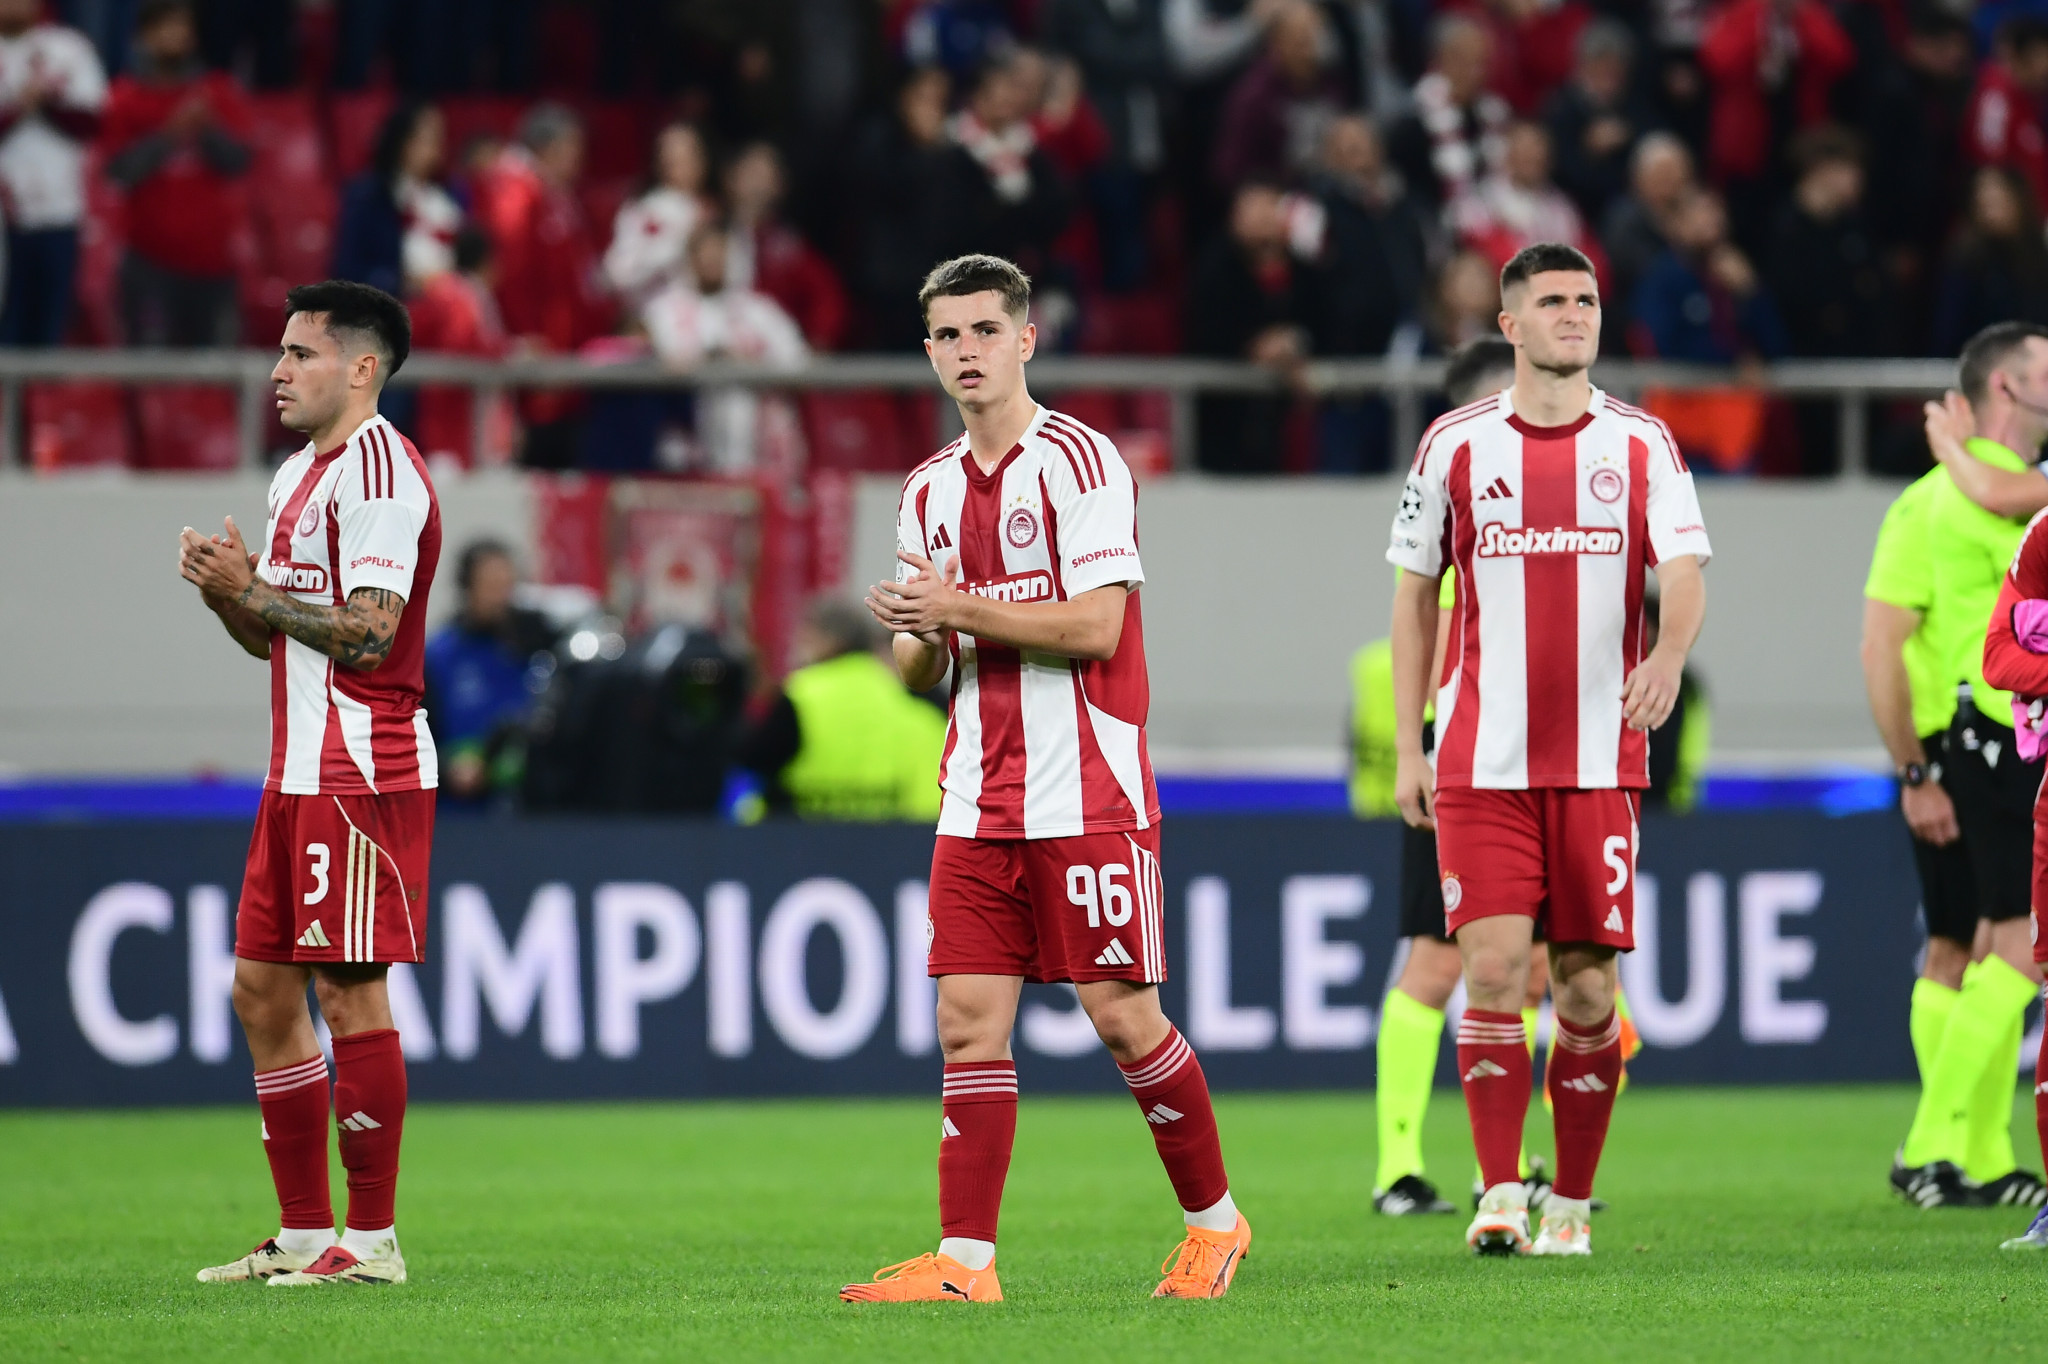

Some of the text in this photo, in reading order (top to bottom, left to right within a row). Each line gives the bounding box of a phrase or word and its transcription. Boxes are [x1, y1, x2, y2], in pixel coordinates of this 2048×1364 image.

[1480, 523, 1621, 556] Stoiximan
[957, 575, 1049, 602] iximan
[304, 842, 331, 905] 3
[1066, 863, 1133, 928] 96
[1603, 835, 1628, 896] 5
[1184, 869, 1829, 1056] LEUE
